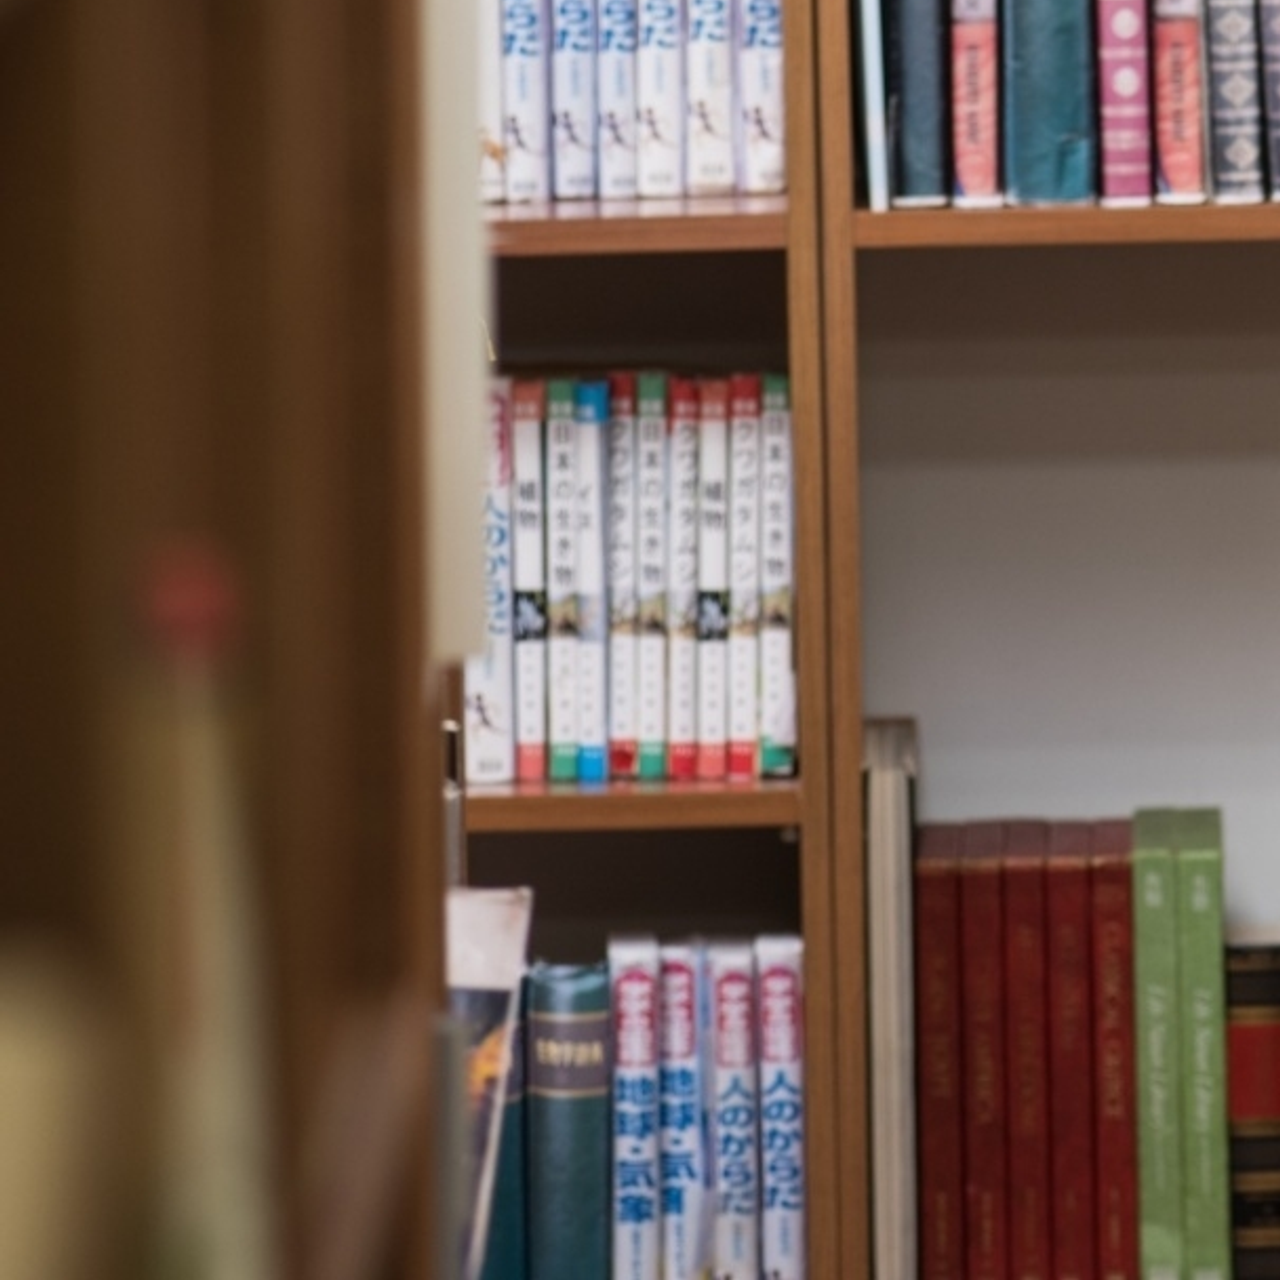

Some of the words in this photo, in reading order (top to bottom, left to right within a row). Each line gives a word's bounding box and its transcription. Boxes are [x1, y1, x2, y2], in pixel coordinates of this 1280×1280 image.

[716, 1074, 753, 1215] 人のからだ
[763, 1069, 802, 1210] 人のからだ
